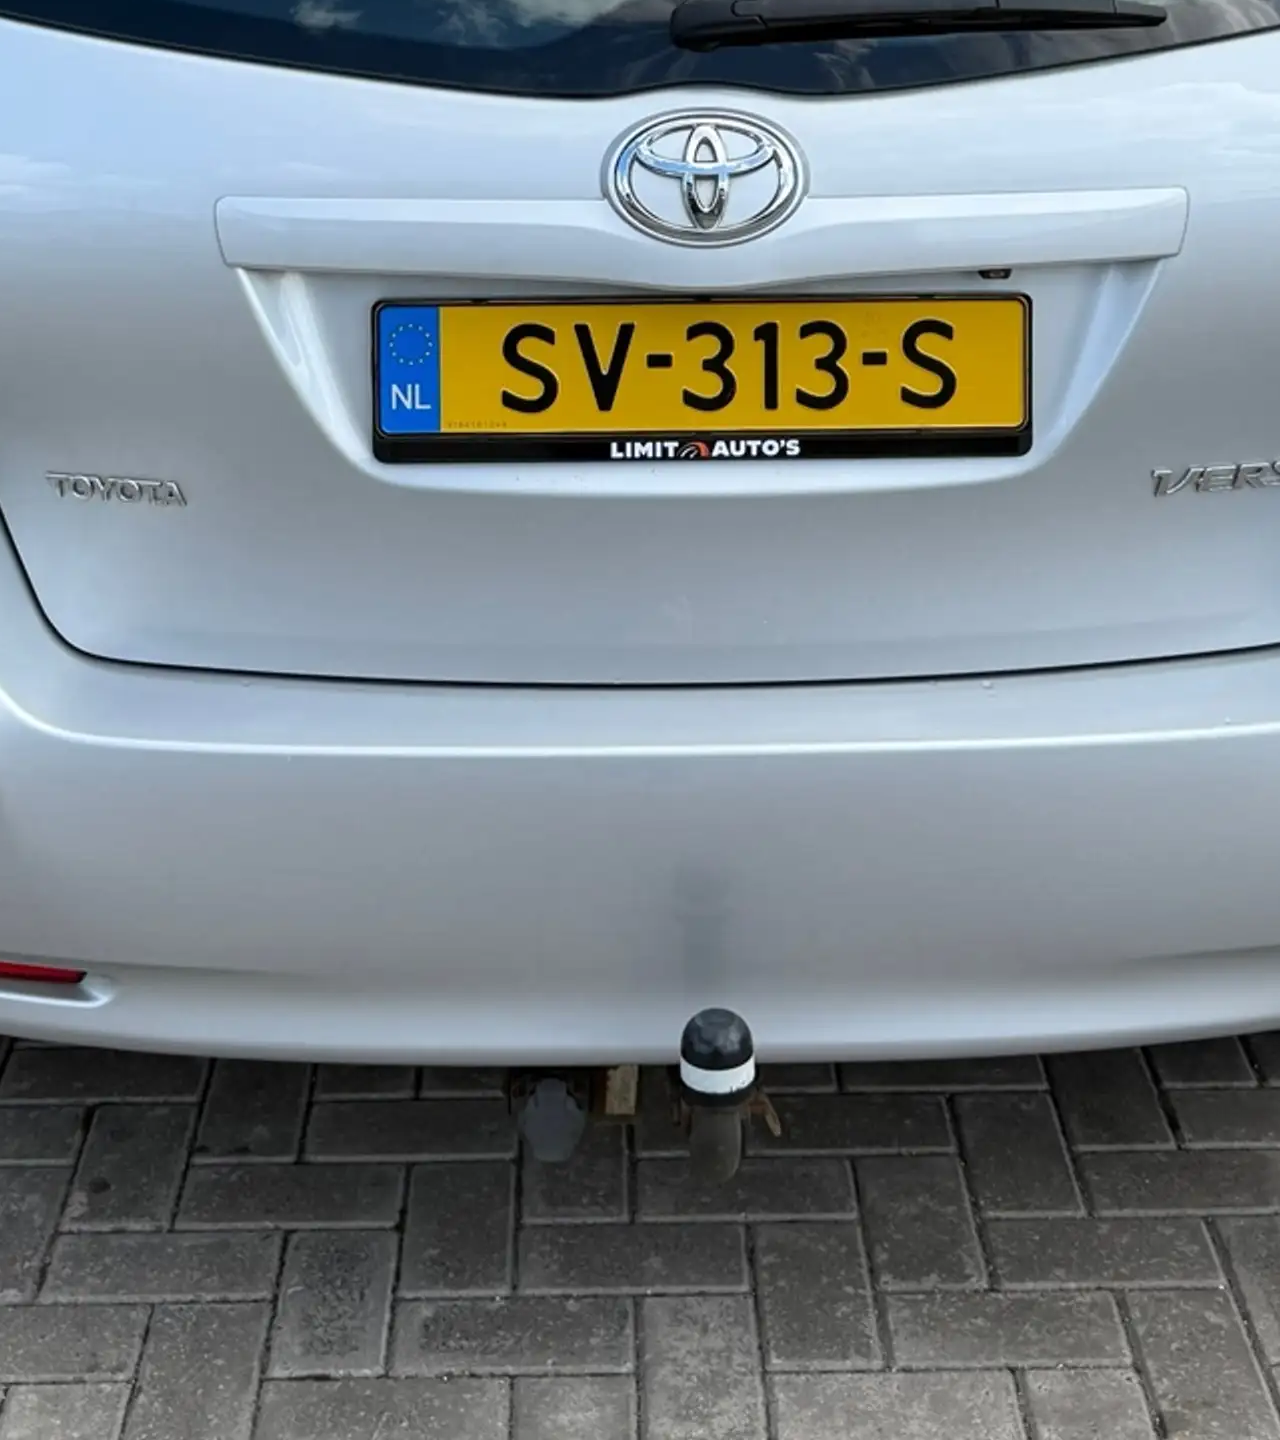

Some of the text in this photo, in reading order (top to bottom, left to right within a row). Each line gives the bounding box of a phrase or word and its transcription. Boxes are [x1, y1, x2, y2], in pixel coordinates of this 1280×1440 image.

[501, 318, 958, 413] SV-313-S
[391, 384, 431, 410] NL
[611, 439, 801, 458] LIMIT AUTO'S
[45, 471, 188, 506] TOYOTA
